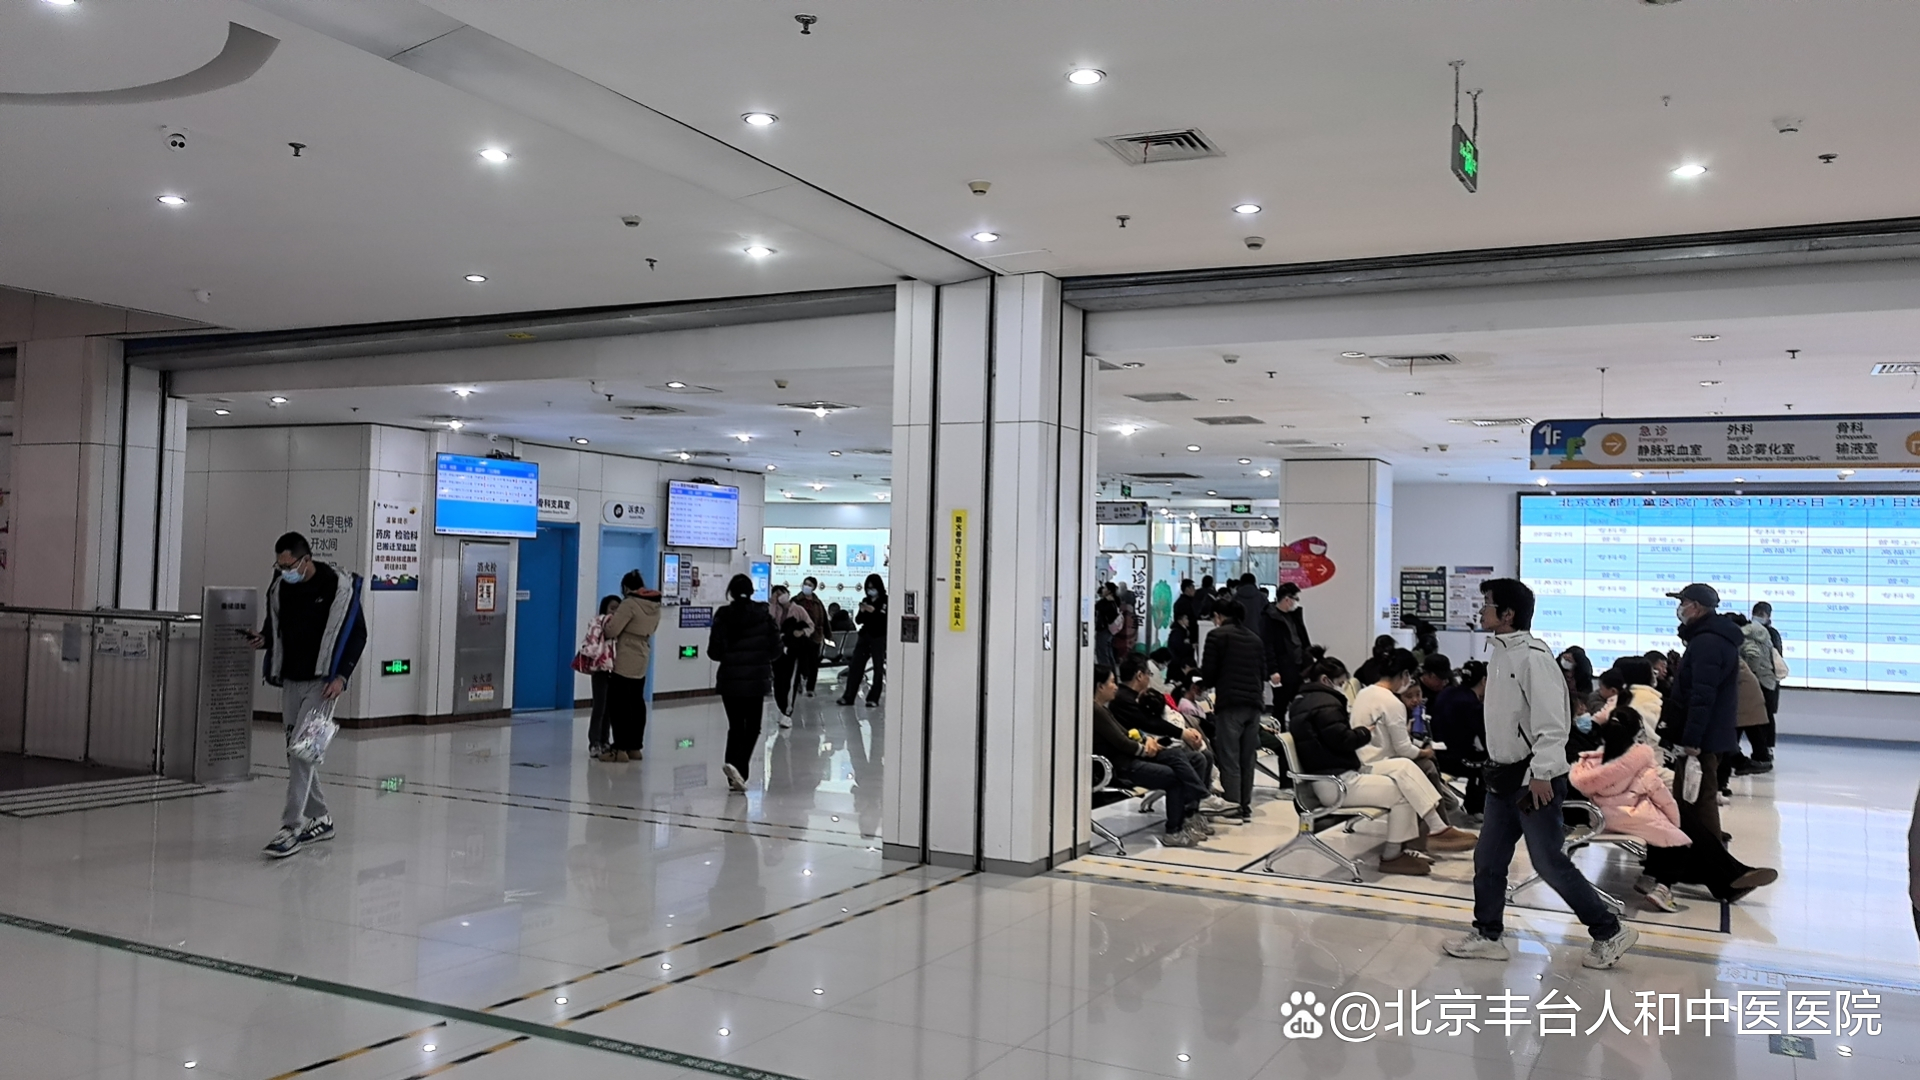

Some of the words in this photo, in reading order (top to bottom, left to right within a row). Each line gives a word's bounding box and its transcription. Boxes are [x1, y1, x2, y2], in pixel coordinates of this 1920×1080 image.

[1639, 425, 1668, 436] 急诊
[1727, 424, 1753, 435] 外科
[1836, 422, 1863, 433] 骨科
[1538, 424, 1562, 445] 1F
[1637, 444, 1703, 456] 静脉采血室
[1726, 443, 1796, 455] 急诊雾化室
[1835, 442, 1879, 454] 输液室
[310, 514, 353, 528] 3.4号电梯
[376, 529, 391, 539] 药房
[395, 530, 418, 540] 检验科
[310, 538, 338, 551] 开水间
